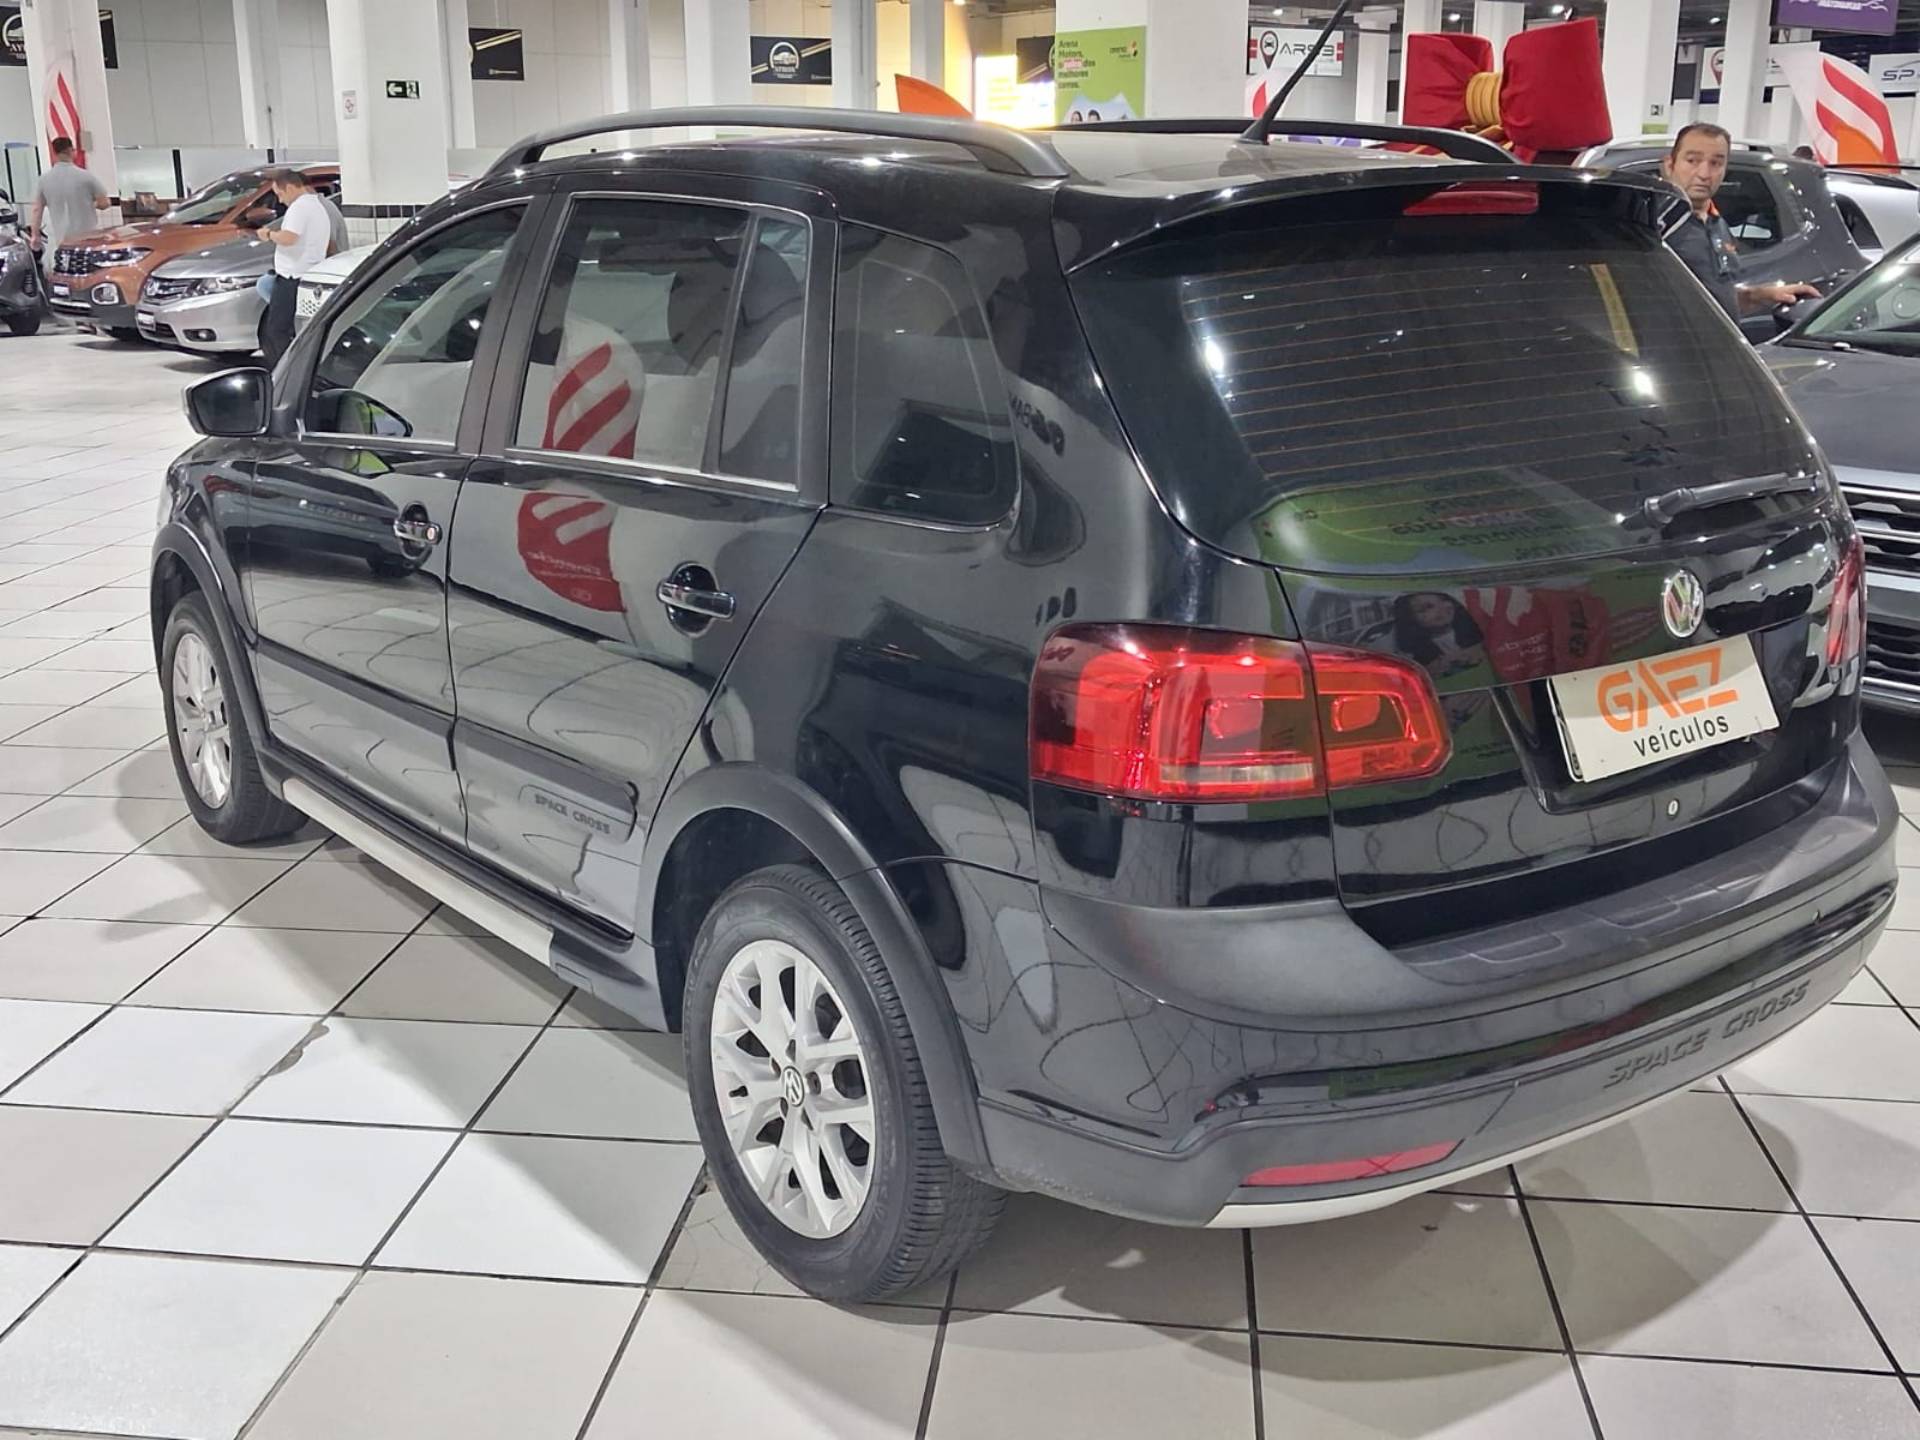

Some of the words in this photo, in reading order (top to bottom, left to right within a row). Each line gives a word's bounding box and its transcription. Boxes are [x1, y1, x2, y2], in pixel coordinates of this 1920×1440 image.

[1881, 69, 1920, 80] SP
[1633, 715, 1730, 757] veículos
[1602, 1028, 1710, 1089] SPACE
[1721, 979, 1811, 1040] CROSS
